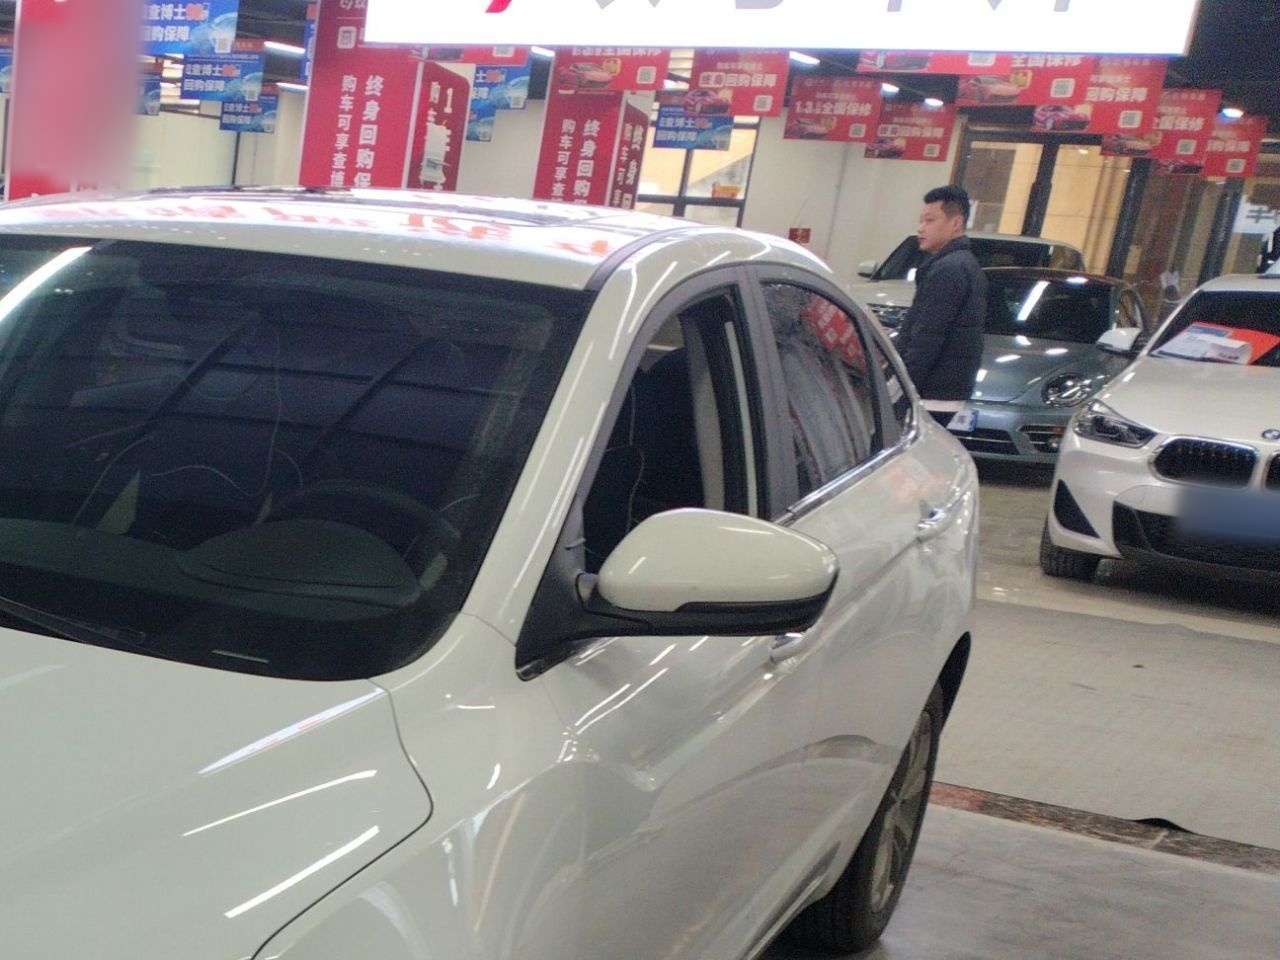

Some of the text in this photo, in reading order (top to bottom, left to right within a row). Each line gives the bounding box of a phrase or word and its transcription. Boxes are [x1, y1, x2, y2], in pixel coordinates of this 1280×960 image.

[551, 118, 577, 201] 购车可享查
